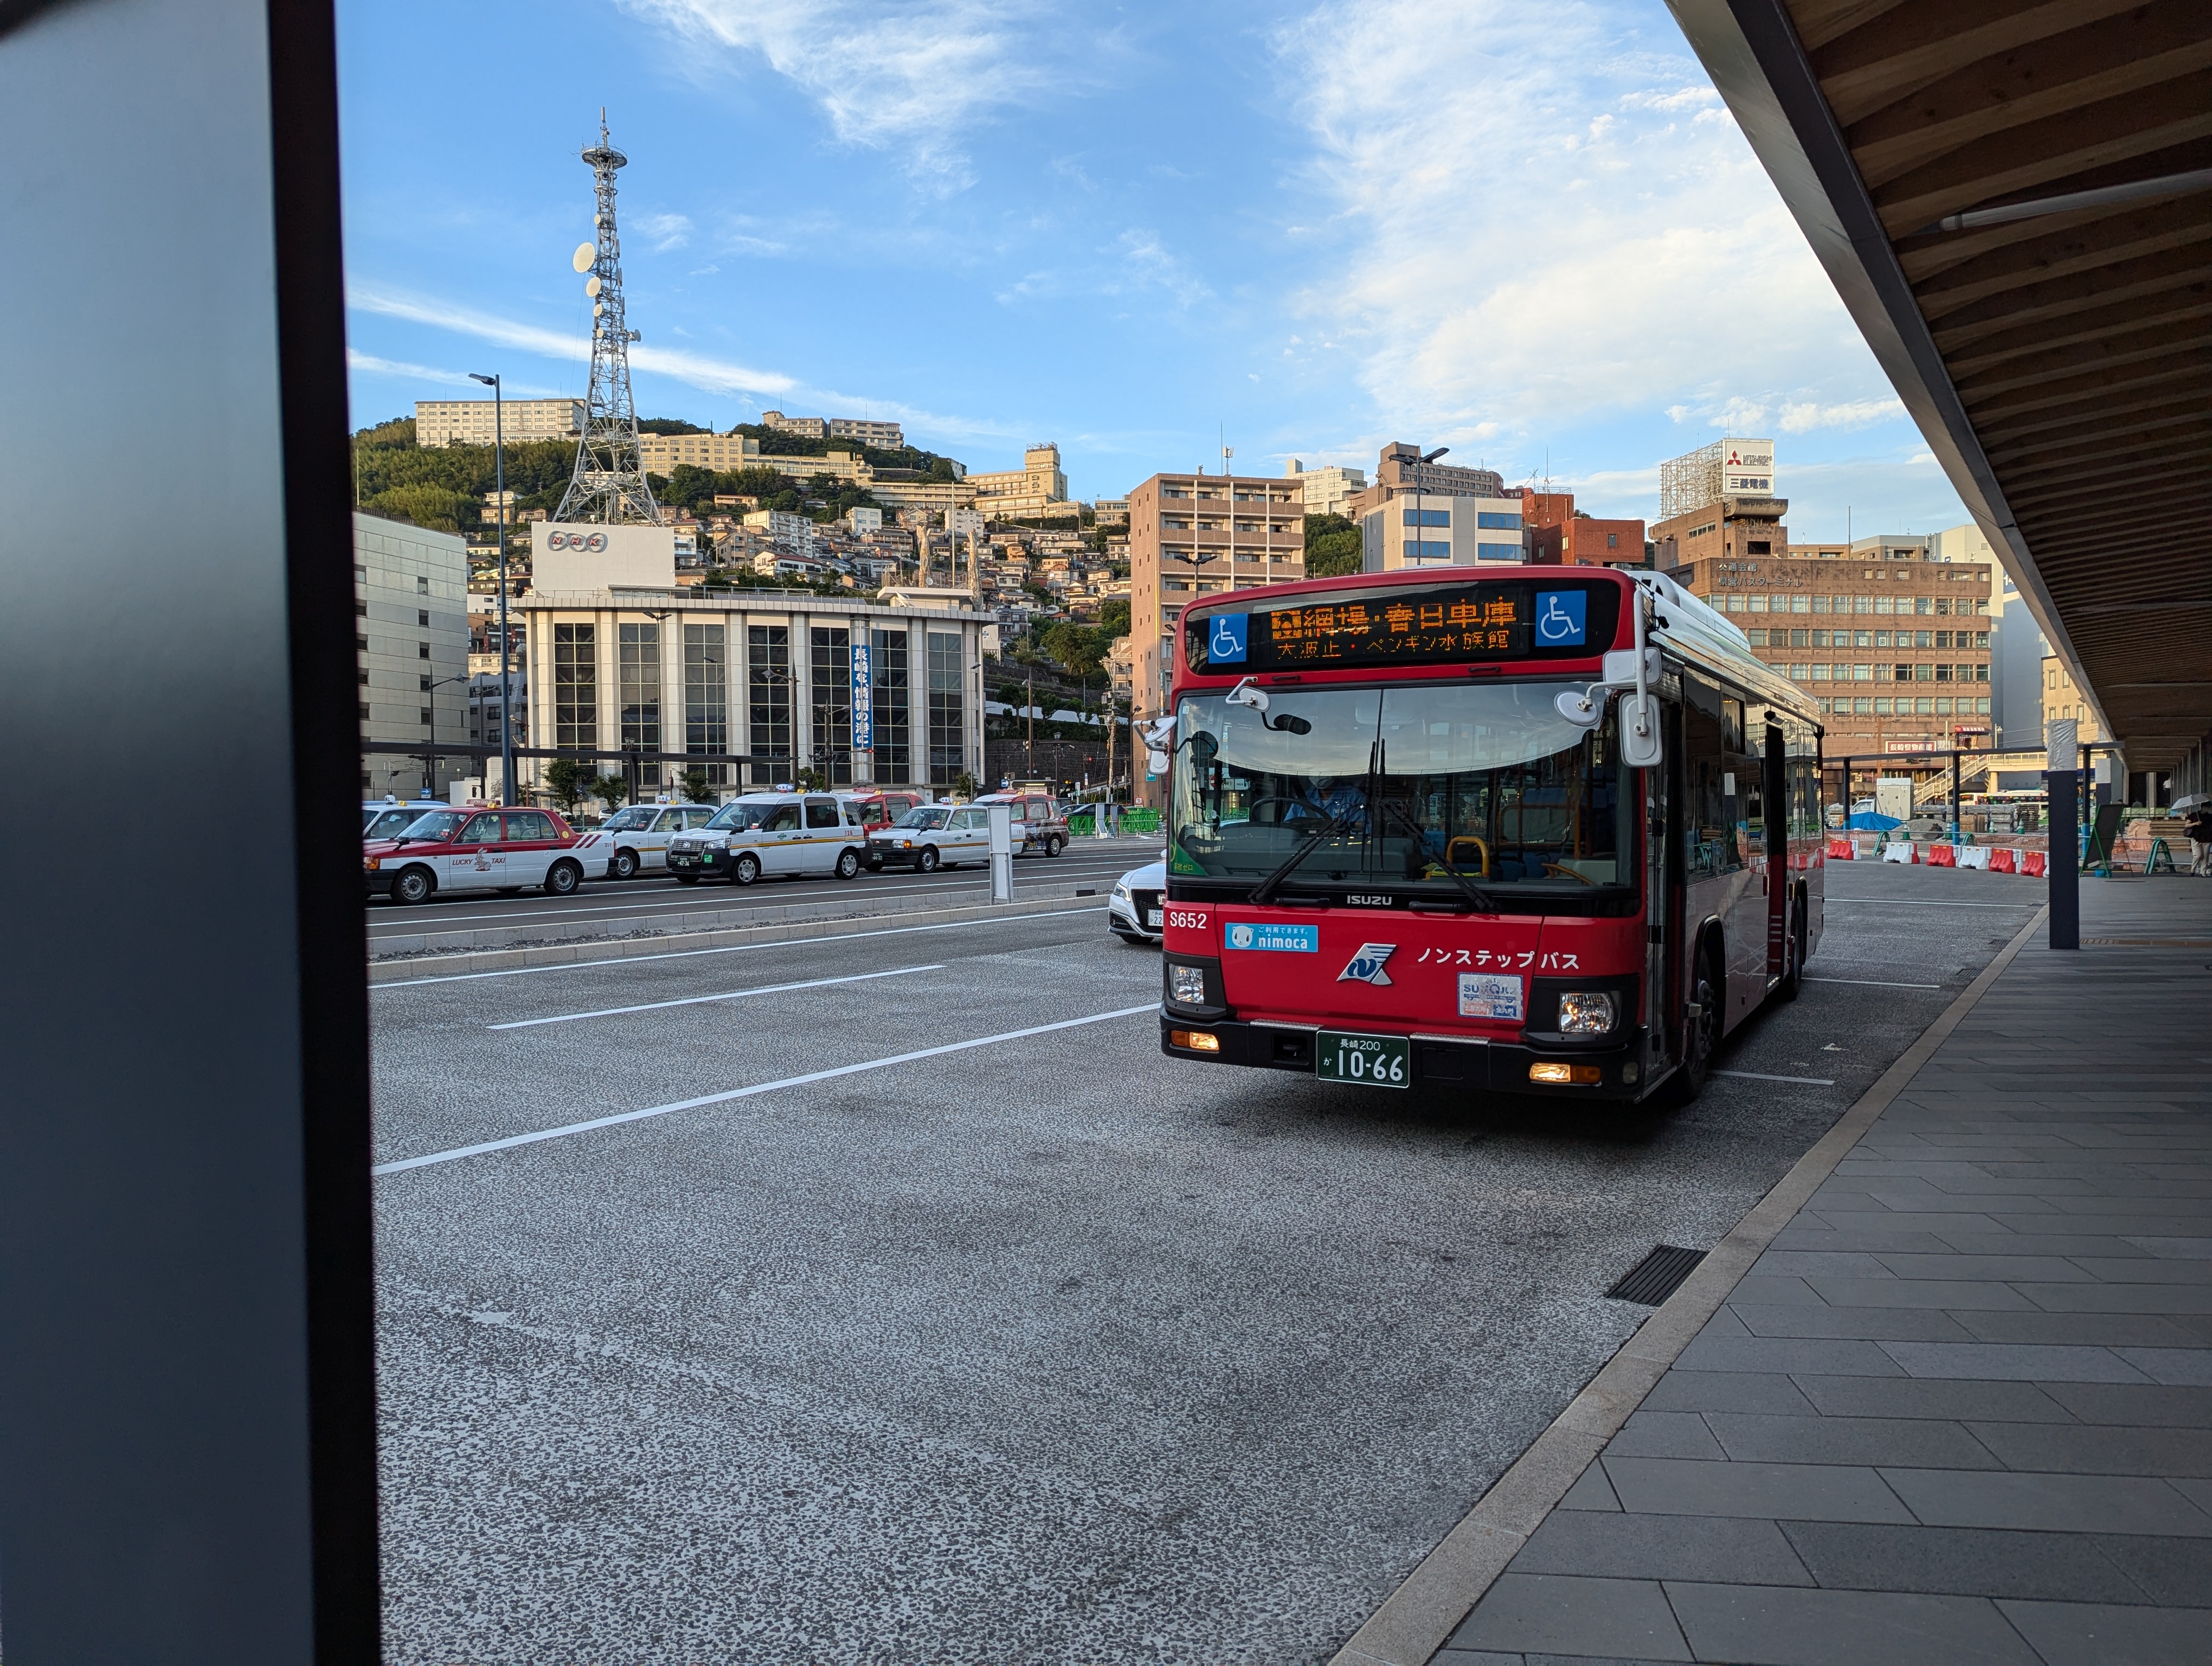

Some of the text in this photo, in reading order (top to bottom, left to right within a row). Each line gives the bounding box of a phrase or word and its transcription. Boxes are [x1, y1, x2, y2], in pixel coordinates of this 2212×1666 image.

[1729, 478, 1769, 489] 三菱電機
[1719, 562, 1758, 572] 交通会館
[1719, 576, 1803, 588] 県営バスターミナル
[854, 648, 870, 745] 長崎を、情報の港に
[1890, 744, 1933, 752] 長崎県物産館
[1347, 895, 1392, 905] ISUZU
[1169, 912, 1207, 929] S652
[1258, 927, 1308, 935] ご利用できます。
[1258, 934, 1308, 949] nimoca
[1418, 948, 1579, 970] ノンステップバス
[1340, 1039, 1386, 1051] 長崎200
[1323, 1050, 1403, 1081] か 10-66
